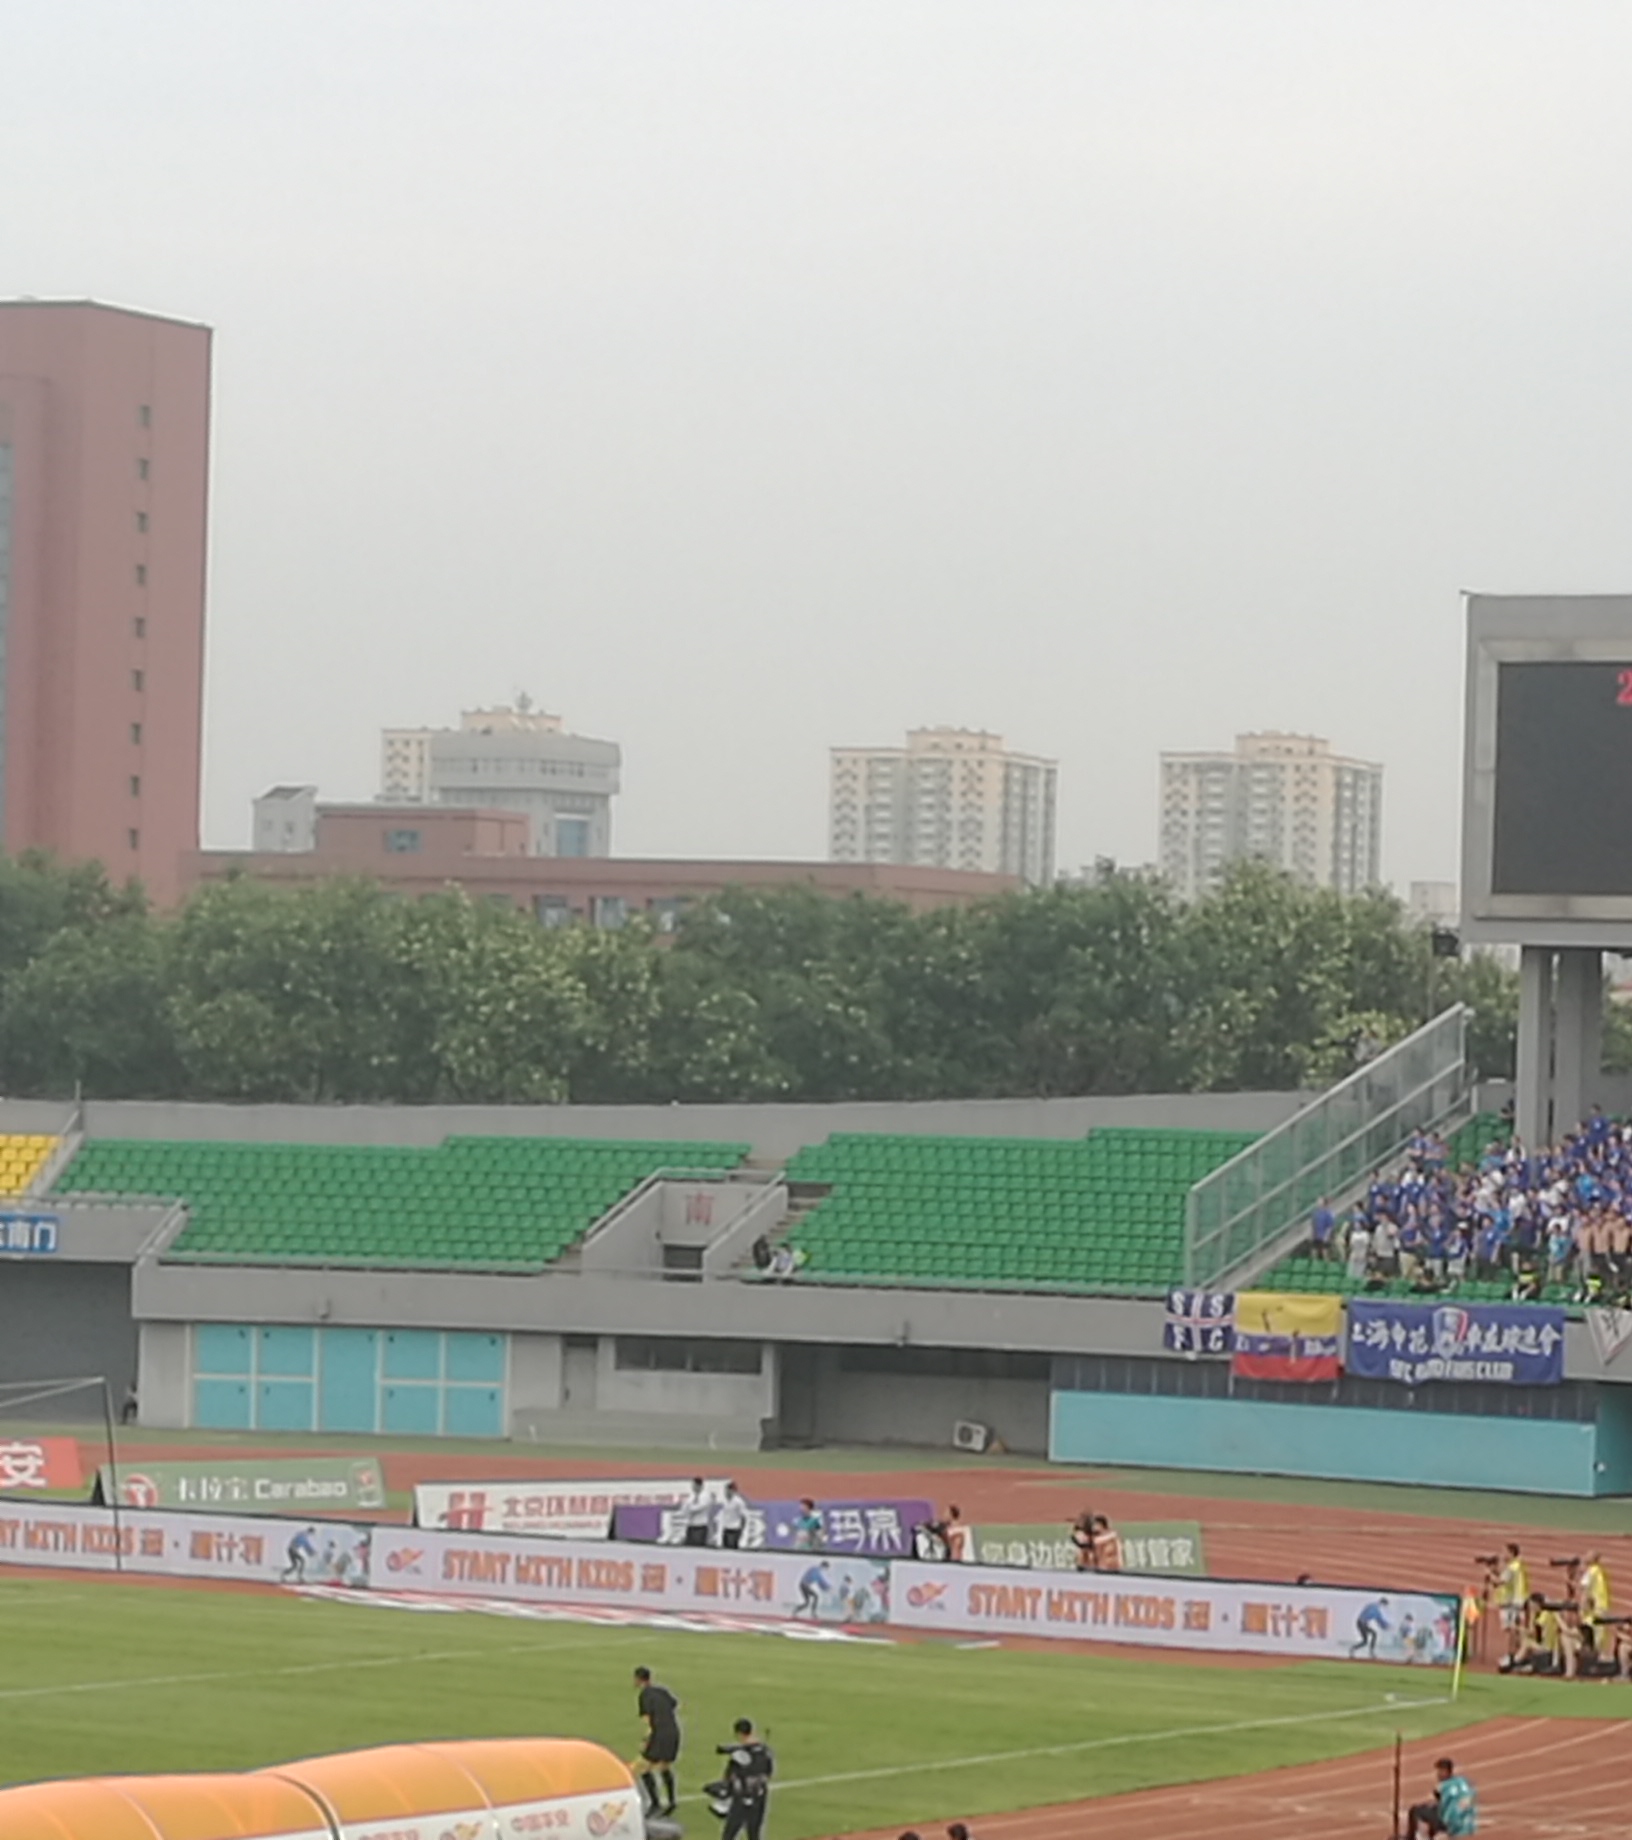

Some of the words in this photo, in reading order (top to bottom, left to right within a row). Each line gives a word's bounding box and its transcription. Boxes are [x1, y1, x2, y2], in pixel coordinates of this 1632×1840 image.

[254, 1476, 349, 1500] Carabao
[443, 1548, 510, 1584] START
[515, 1555, 573, 1589] WITH
[577, 1558, 635, 1592] KIDS
[968, 1584, 1042, 1620] START
[1047, 1589, 1109, 1625] WITH
[1114, 1593, 1176, 1630] KIDS
